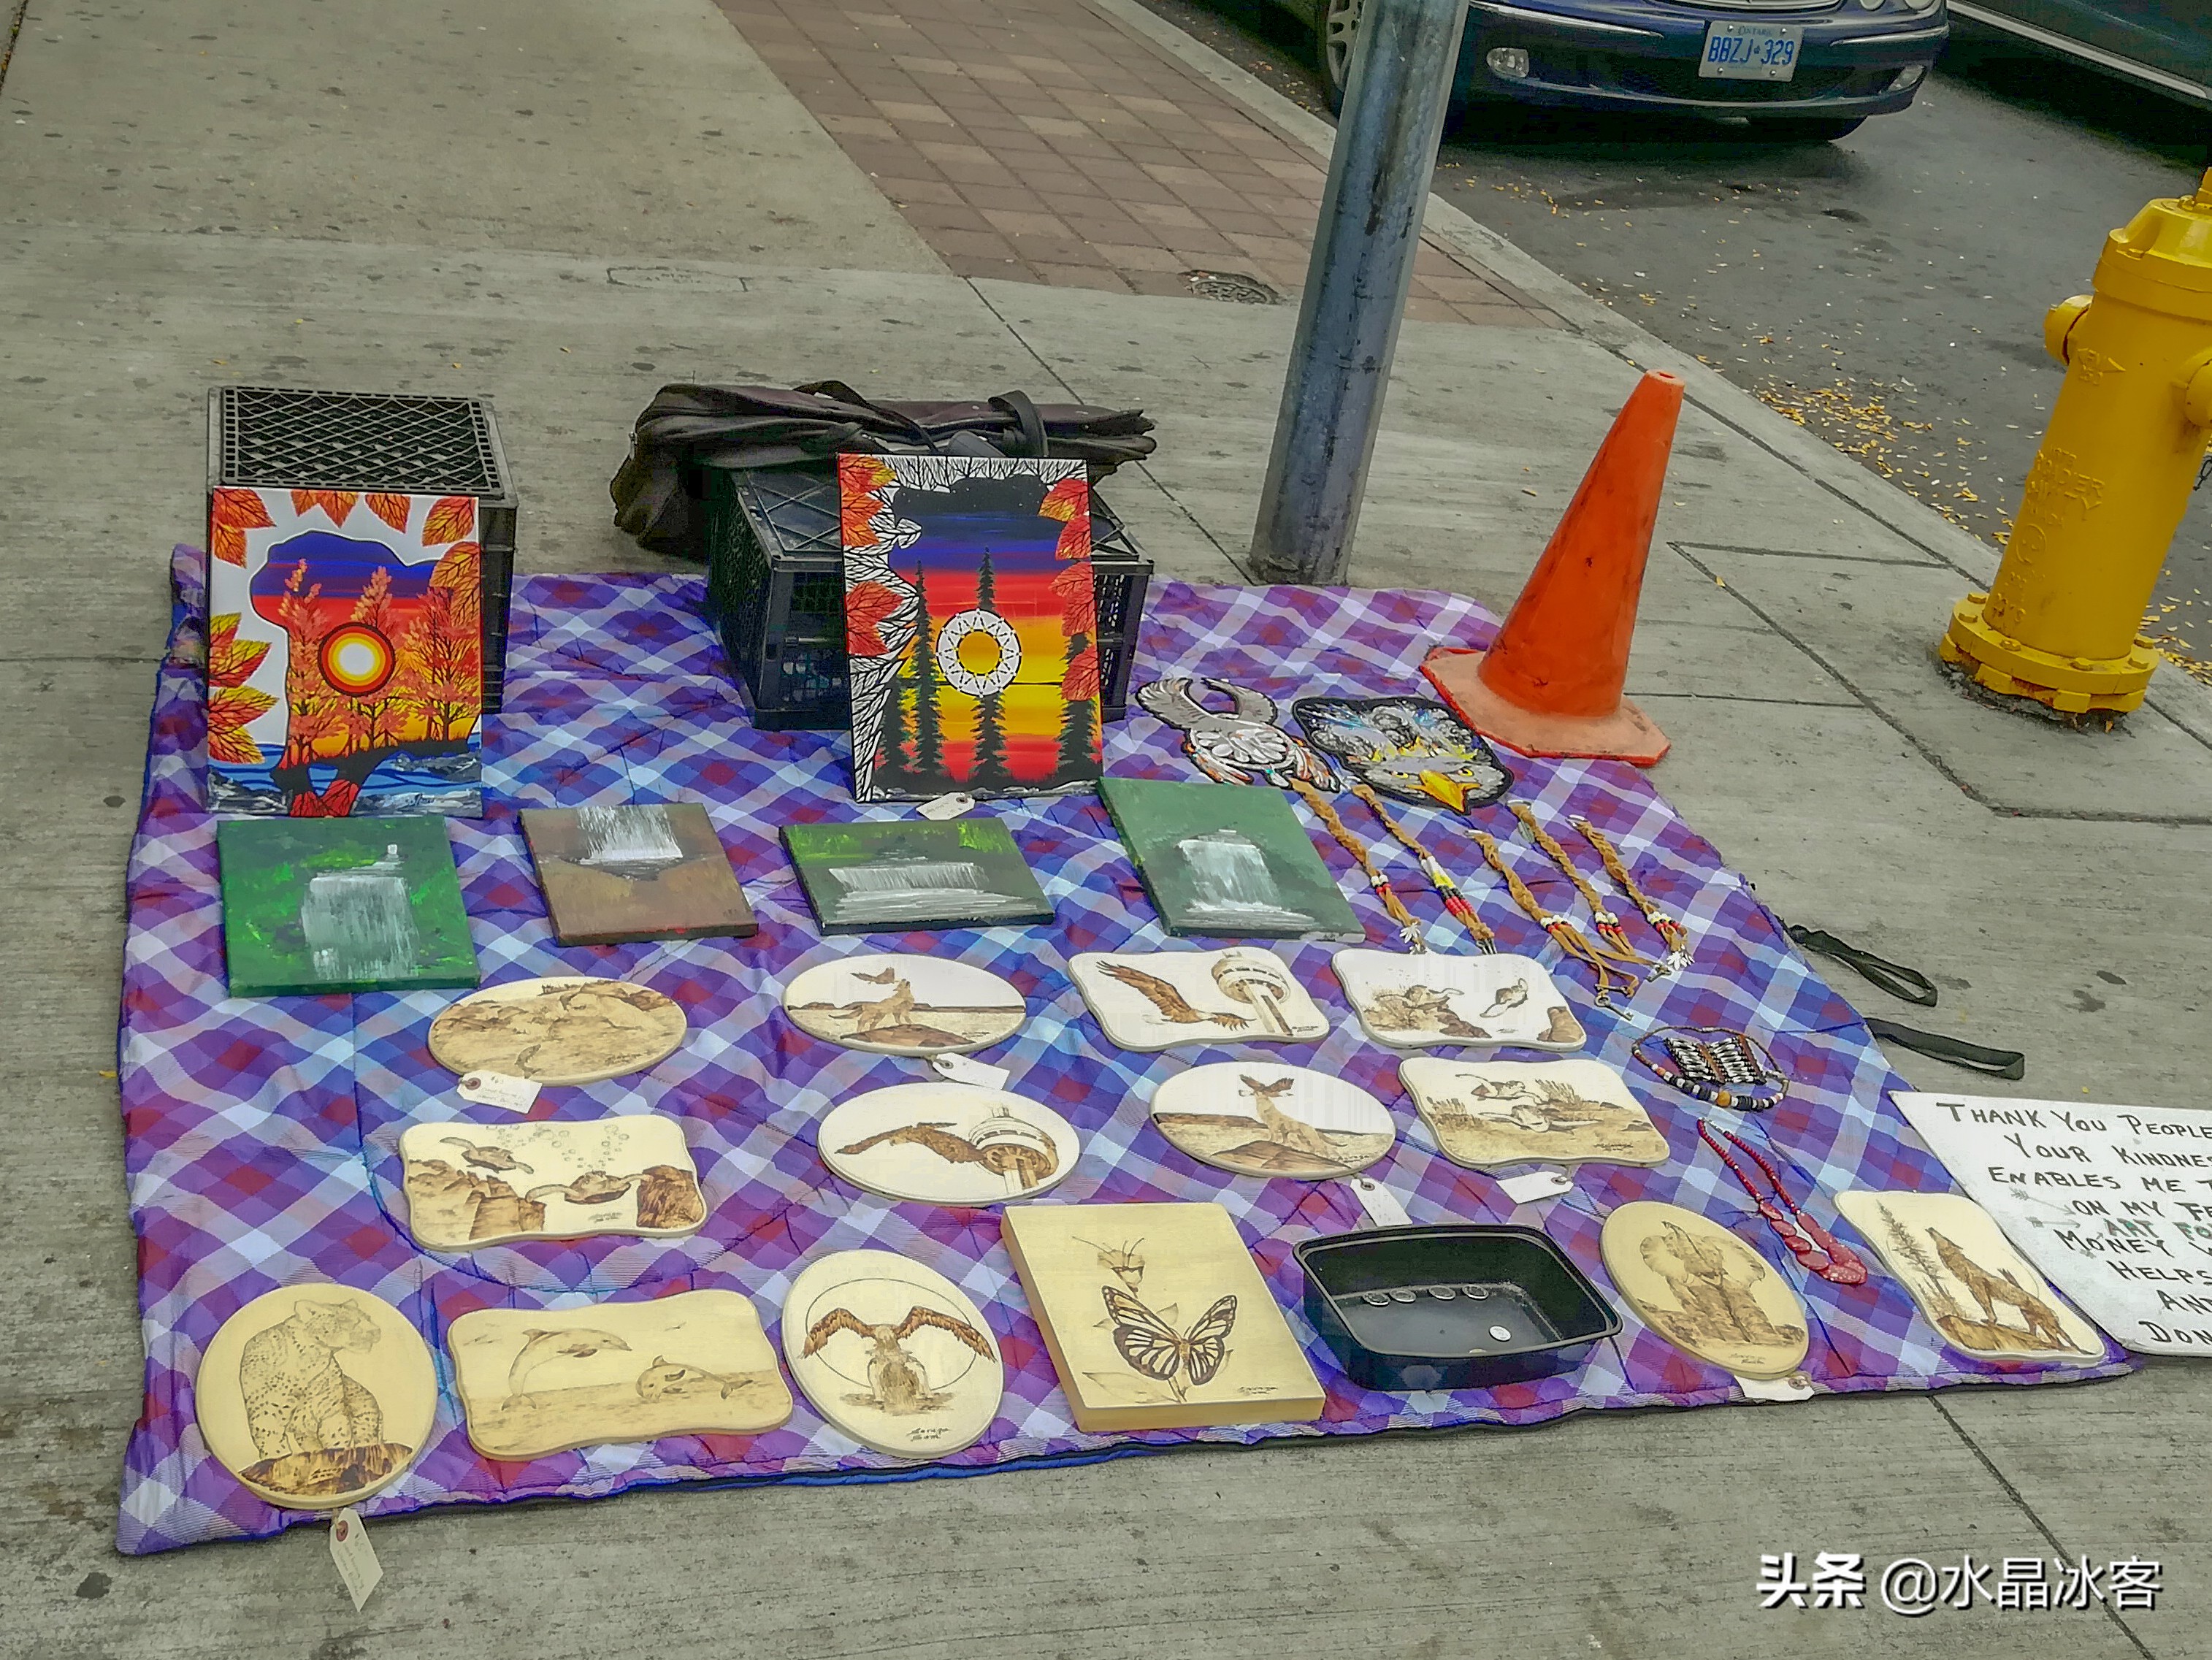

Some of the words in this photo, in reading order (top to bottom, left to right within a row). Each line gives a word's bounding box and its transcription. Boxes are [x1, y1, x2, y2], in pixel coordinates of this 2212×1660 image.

[1707, 36, 1753, 64] BBZJ
[1761, 39, 1794, 66] 329
[1936, 1102, 2046, 1128] THANK
[2050, 1110, 2107, 1132] YOU
[2116, 1114, 2212, 1139] PEOPLE
[2004, 1133, 2092, 1163] YOUR
[1988, 1166, 2121, 1189] ENABLES
[2140, 1177, 2186, 1193] ME
[2072, 1200, 2110, 1215] ON
[2120, 1201, 2165, 1217] MY
[2054, 1229, 2175, 1258] MONEY
[2172, 1222, 2212, 1241] FO
[2106, 1261, 2212, 1285] HELPS
